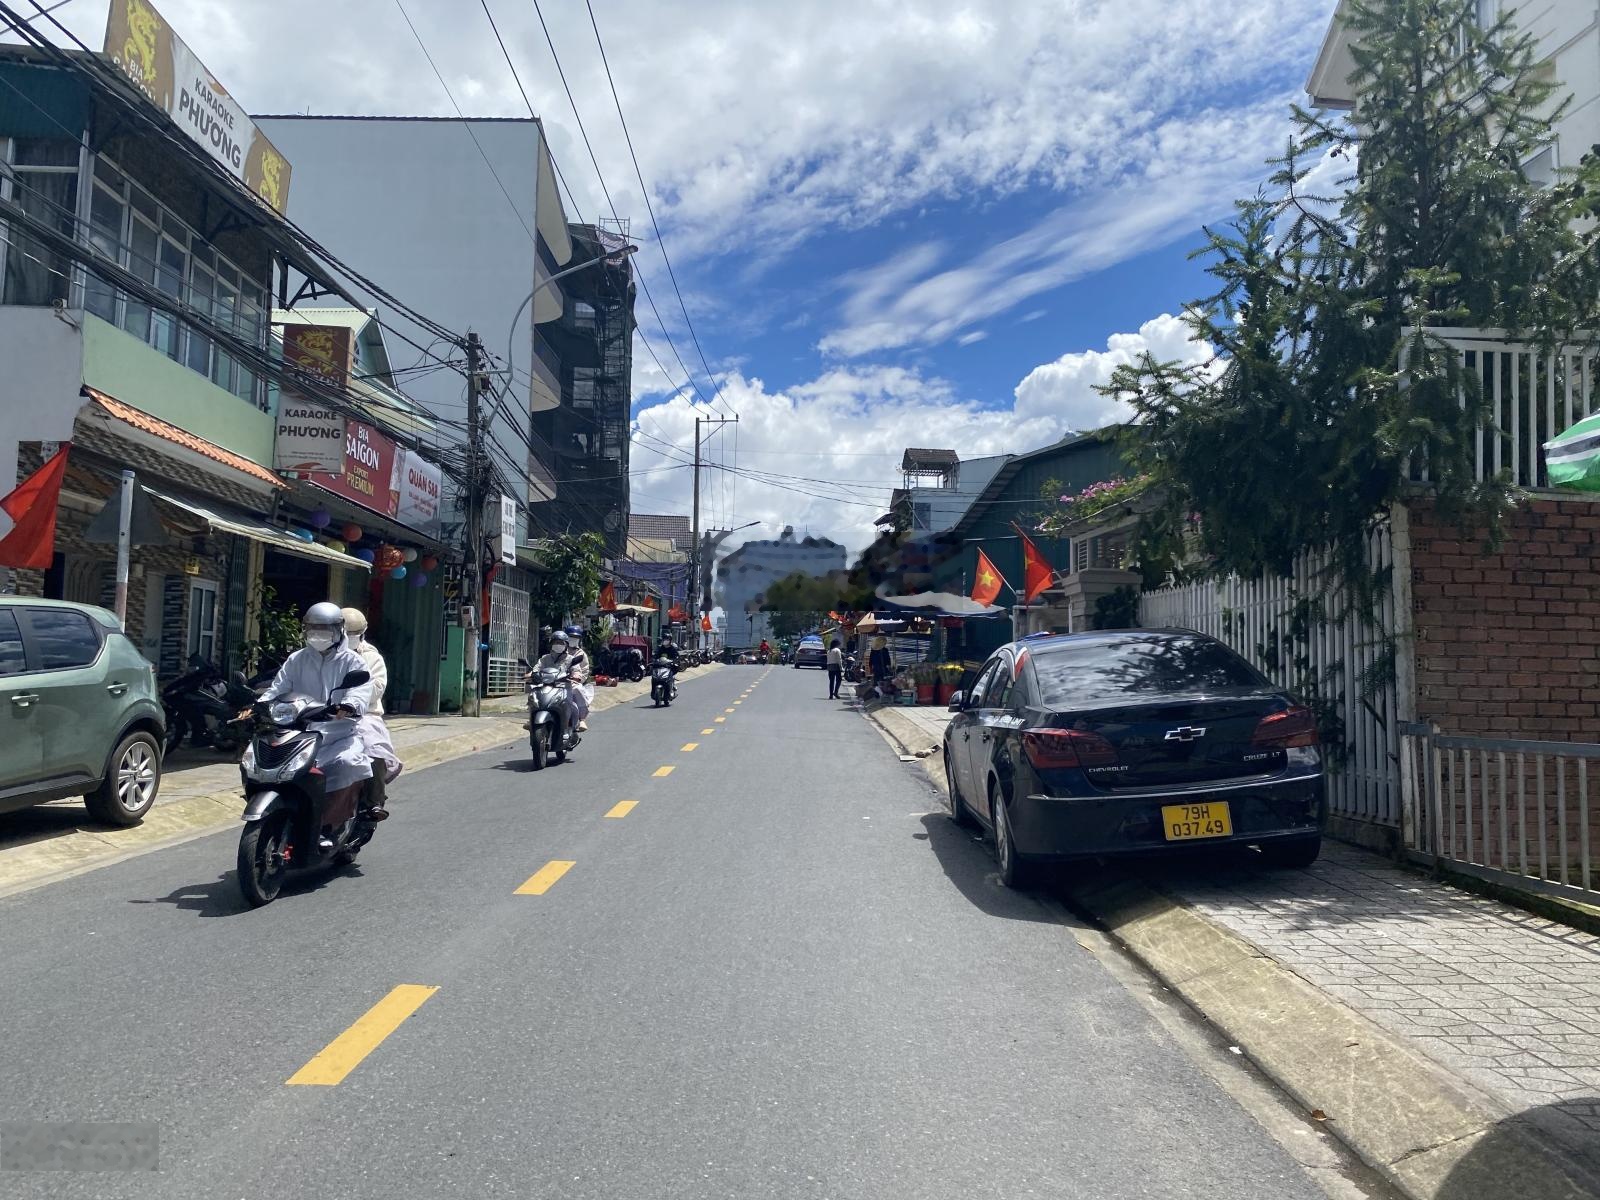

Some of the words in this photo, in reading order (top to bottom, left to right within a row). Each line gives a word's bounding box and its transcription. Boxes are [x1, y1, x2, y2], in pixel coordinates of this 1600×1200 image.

[130, 59, 143, 80] BIA
[195, 77, 234, 130] KARAOKE
[180, 88, 242, 169] PHƯƠNG
[285, 408, 337, 420] KARAOKE
[279, 424, 341, 439] PHƯƠNG
[358, 426, 369, 443] BIA
[346, 434, 380, 471] SAIGON
[346, 472, 374, 497] PREMIUM
[408, 467, 427, 493] QUÁN
[1088, 765, 1129, 773] CHEVROLET
[1182, 806, 1210, 820] 79H
[1172, 820, 1224, 838] 037.49
